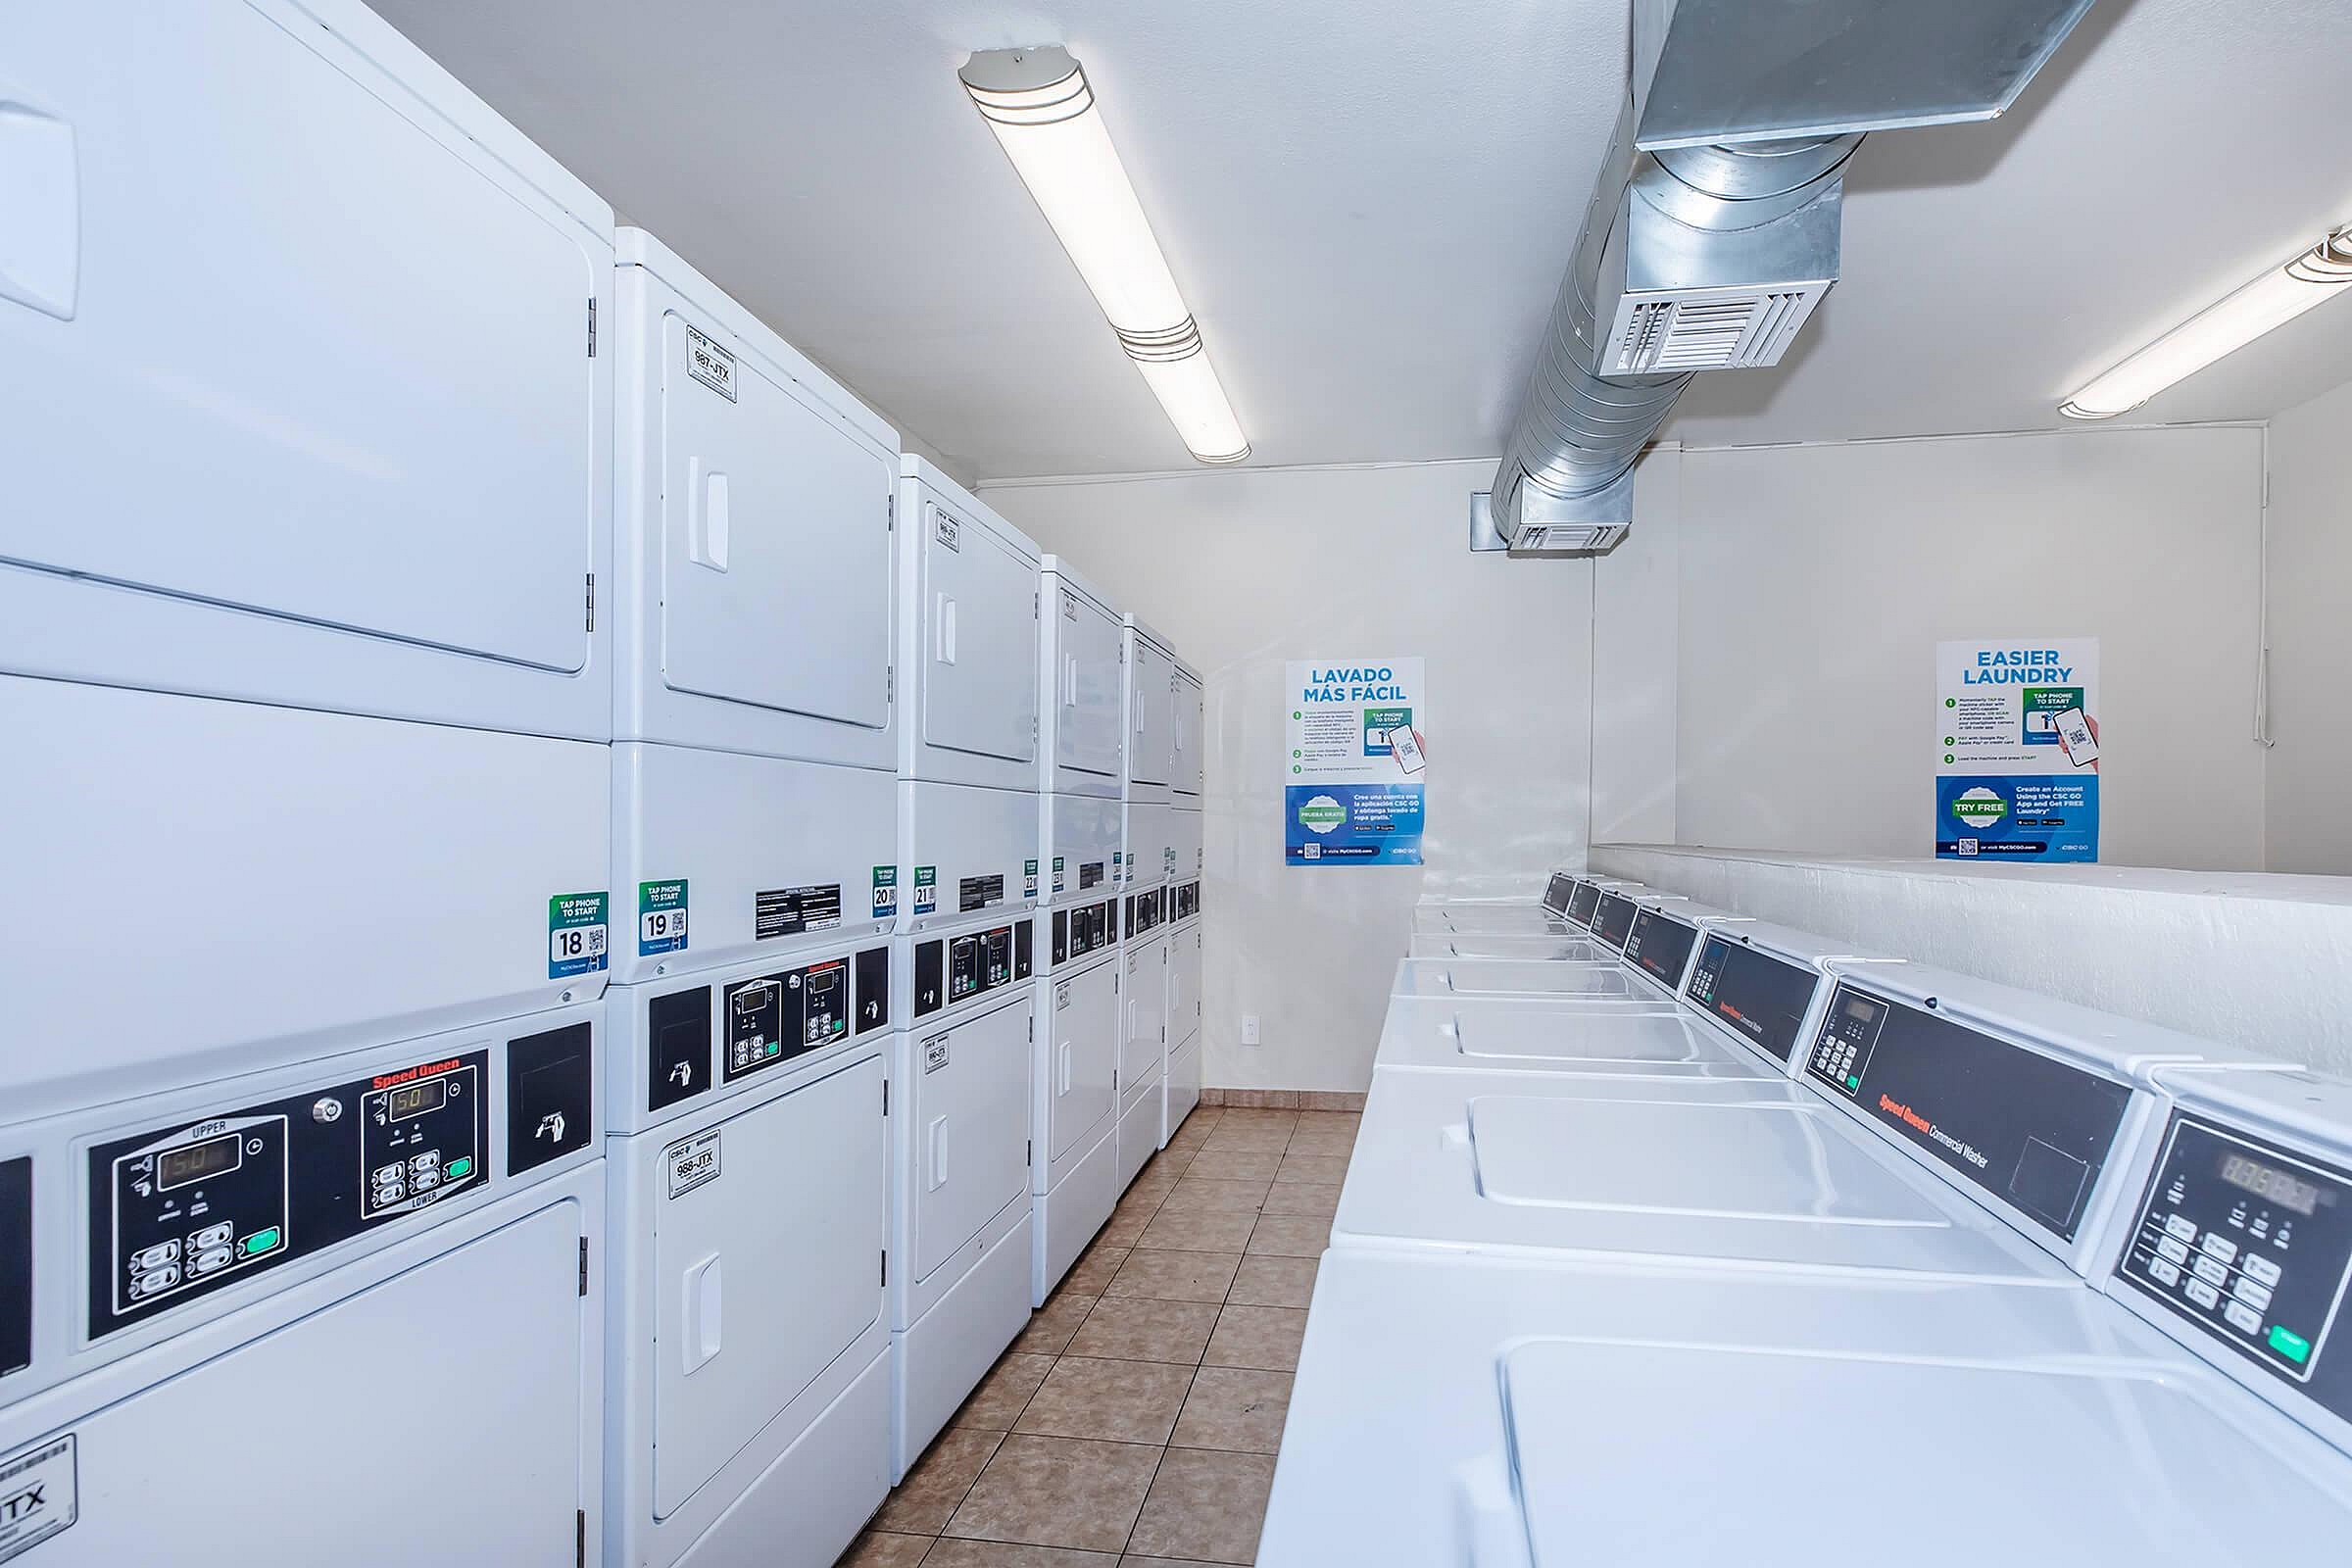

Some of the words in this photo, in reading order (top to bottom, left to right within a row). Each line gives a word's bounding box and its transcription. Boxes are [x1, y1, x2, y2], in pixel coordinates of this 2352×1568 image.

[695, 350, 729, 381] 987-JTX
[1978, 650, 2059, 666] EASIER
[1311, 667, 1393, 684] LAVADO
[1963, 667, 2073, 685] LAUNDRY
[1303, 684, 1346, 702] MÁS
[1351, 683, 1406, 701] FÁCIL
[1955, 803, 1975, 812] TRY
[1978, 803, 2004, 811] FREE
[660, 892, 679, 901] START
[661, 885, 681, 893] PHONE
[876, 889, 887, 905] 20
[917, 888, 926, 903] 21
[560, 901, 574, 909] TAP
[575, 898, 600, 907] PHONE
[575, 906, 597, 916] START
[647, 915, 666, 936] 19
[560, 931, 582, 956] 18
[373, 1068, 417, 1089] Speed
[419, 1059, 460, 1077] Queen
[192, 1121, 226, 1138] UPPER
[1879, 1093, 1906, 1118] Speed
[1903, 1106, 1930, 1134] Queen
[1929, 1124, 1964, 1154] Commercial
[1963, 1144, 1988, 1168] Washer
[677, 1151, 713, 1176] 988-JTX
[412, 1191, 438, 1208] LOWER
[0, 1484, 45, 1523] TX
